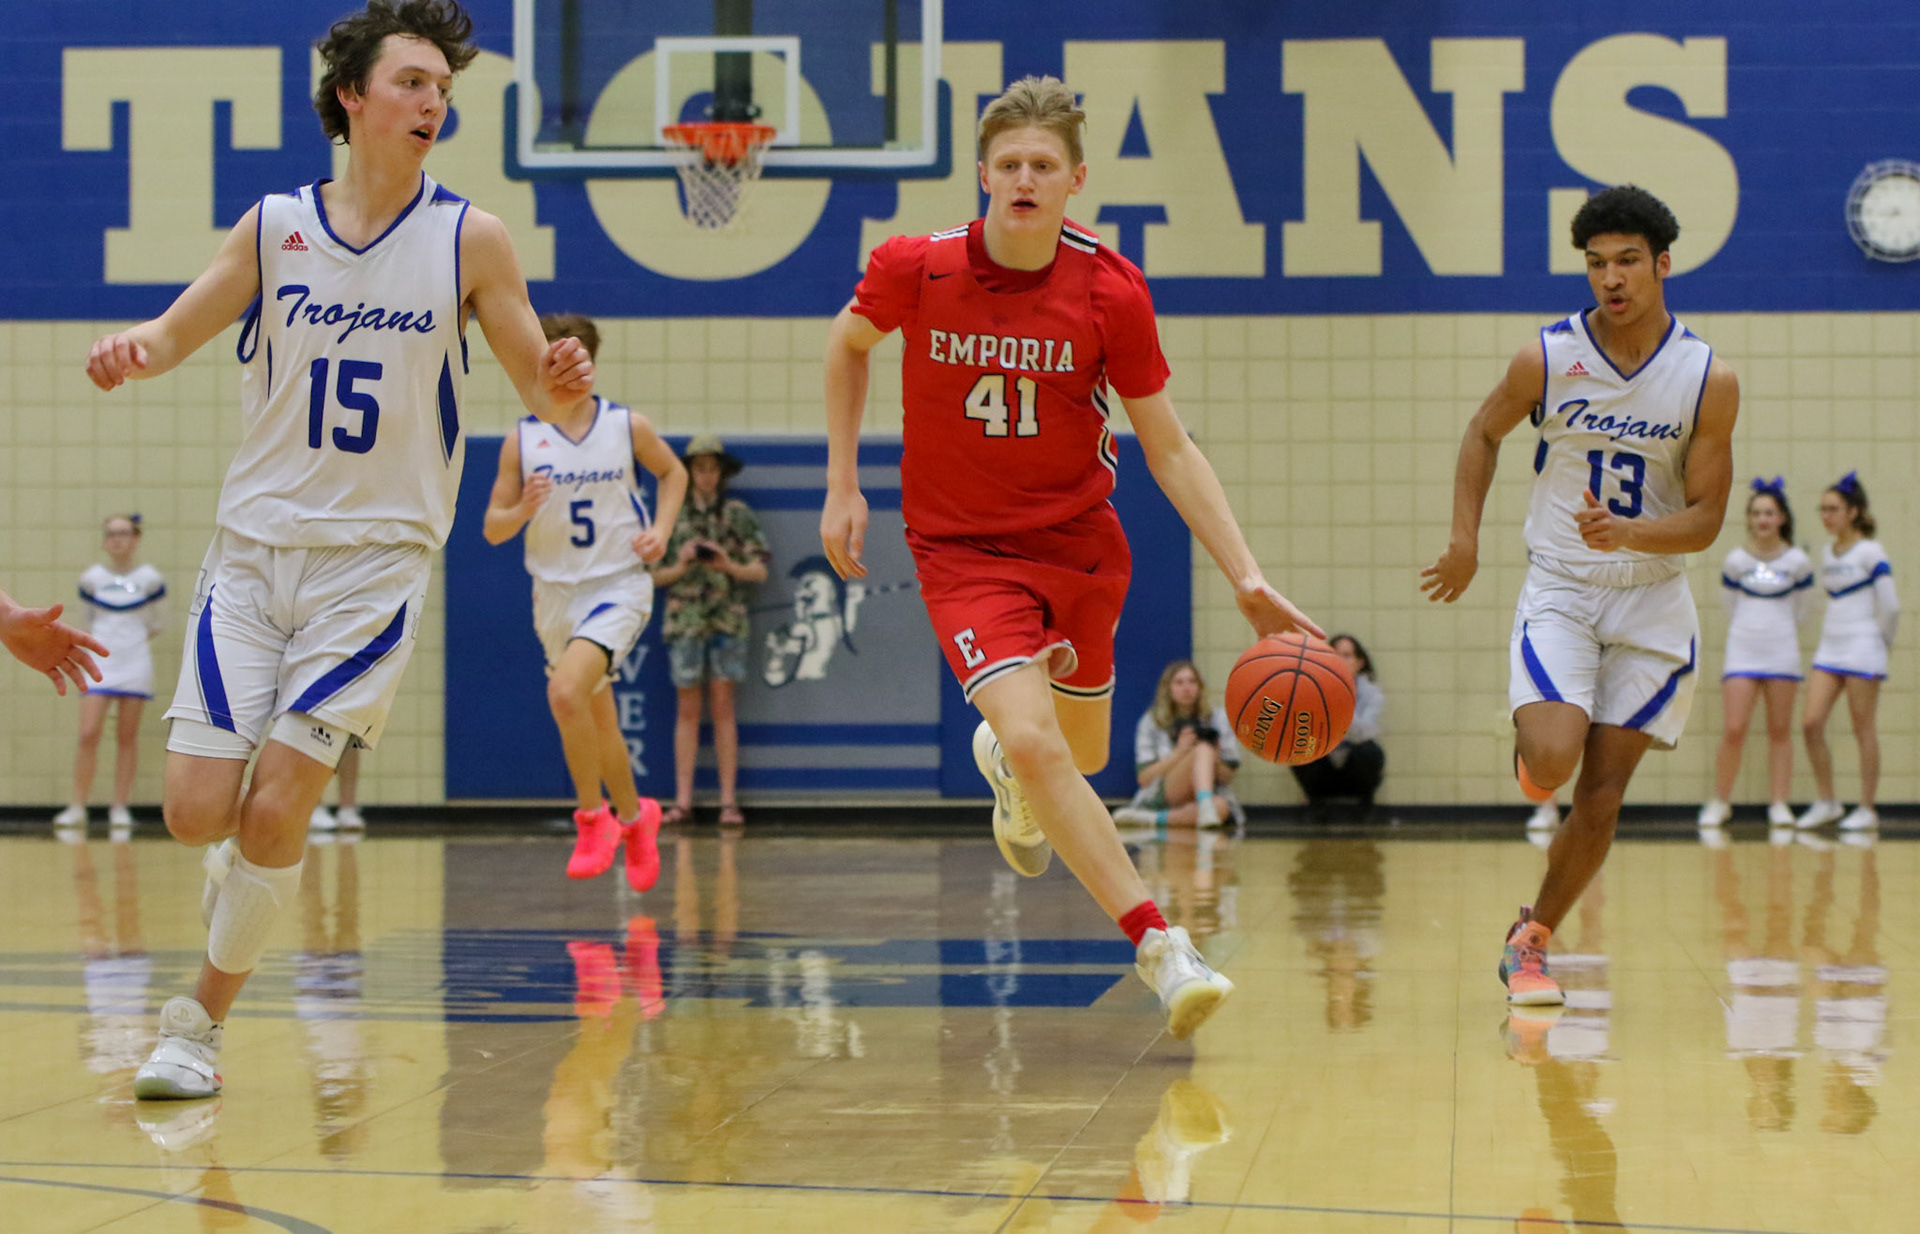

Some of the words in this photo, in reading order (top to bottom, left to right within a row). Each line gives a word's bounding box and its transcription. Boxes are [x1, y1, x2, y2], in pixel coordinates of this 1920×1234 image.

[281, 243, 309, 251] adidas
[276, 284, 437, 345] Trojans
[929, 328, 1075, 373] EMPORIA
[307, 357, 383, 454] 15
[964, 373, 1040, 438] 41
[1557, 398, 1684, 442] Trojans
[533, 464, 624, 493] Trojans
[1587, 450, 1646, 519] 13
[570, 500, 596, 549] 5
[952, 627, 988, 670] E
[1293, 711, 1313, 755] 1000
